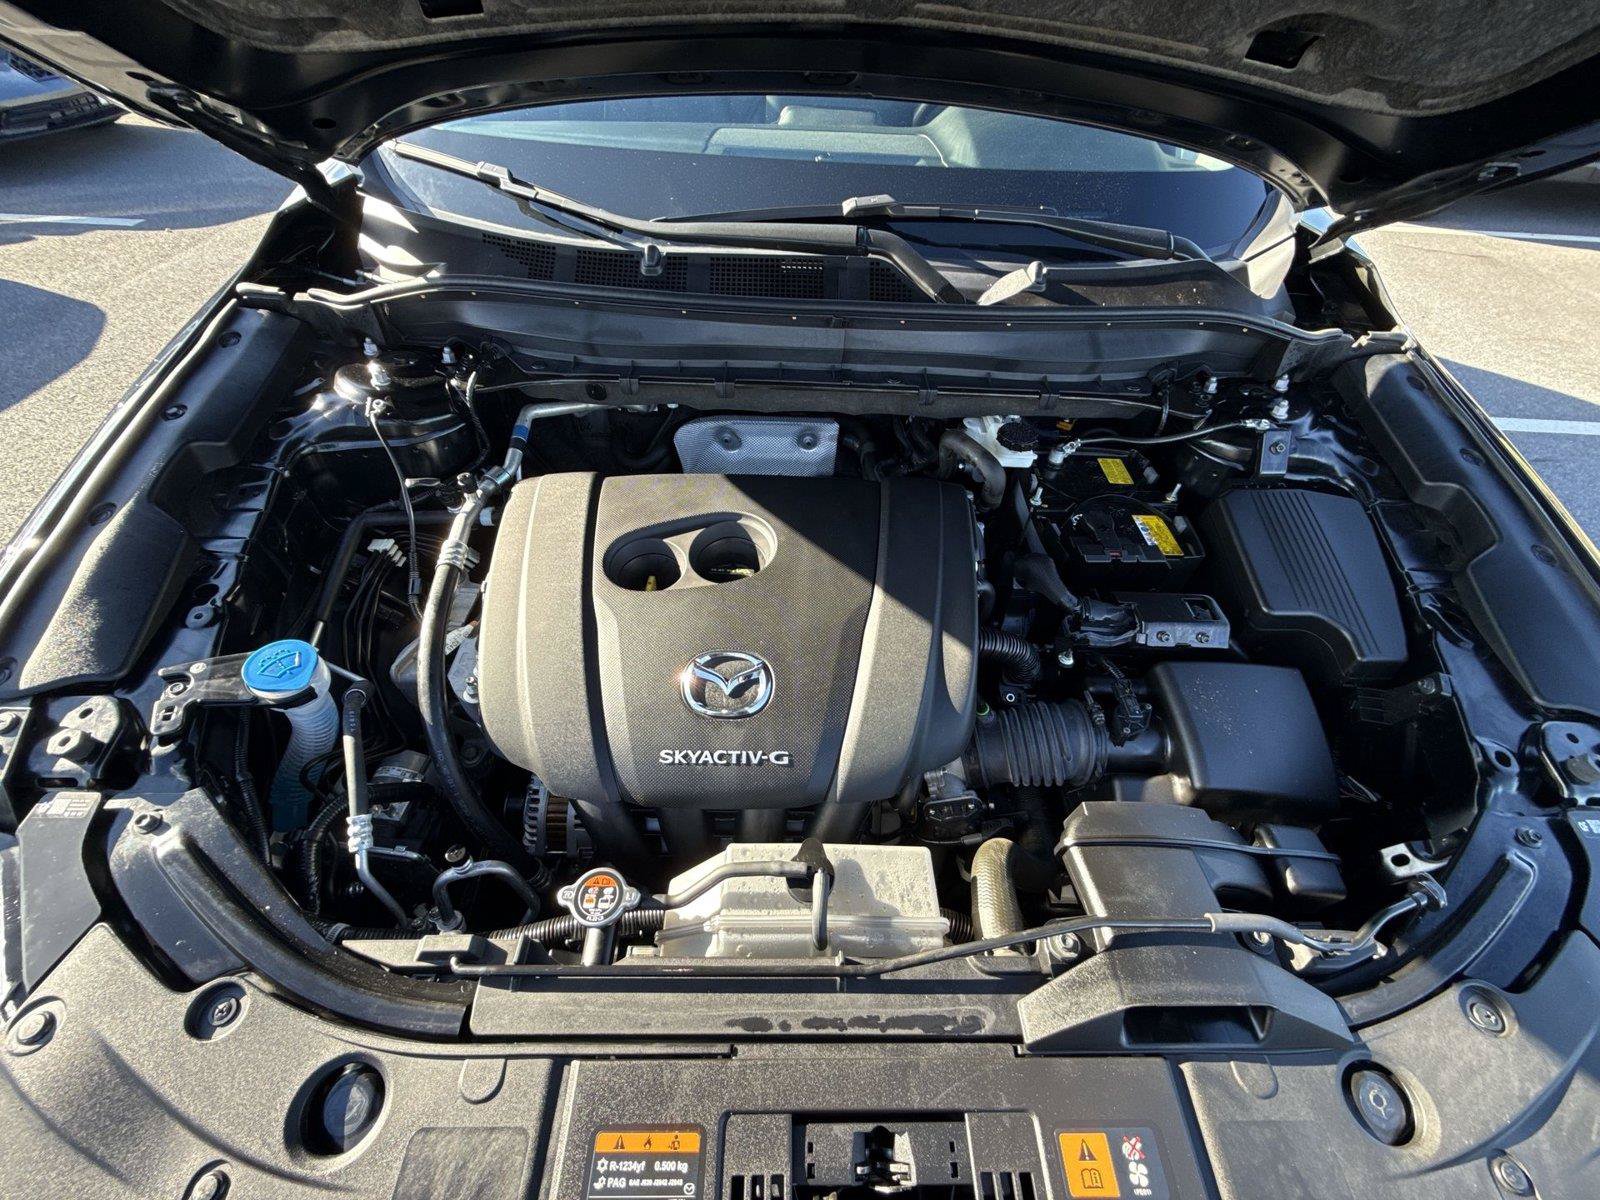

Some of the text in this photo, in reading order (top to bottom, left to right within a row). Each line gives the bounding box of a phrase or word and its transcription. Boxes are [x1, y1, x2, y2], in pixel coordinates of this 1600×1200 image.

[659, 749, 789, 765] SKYACTIV-G
[609, 1161, 688, 1173] R-1234yf 0.500 kg
[607, 1178, 626, 1188] PAG
